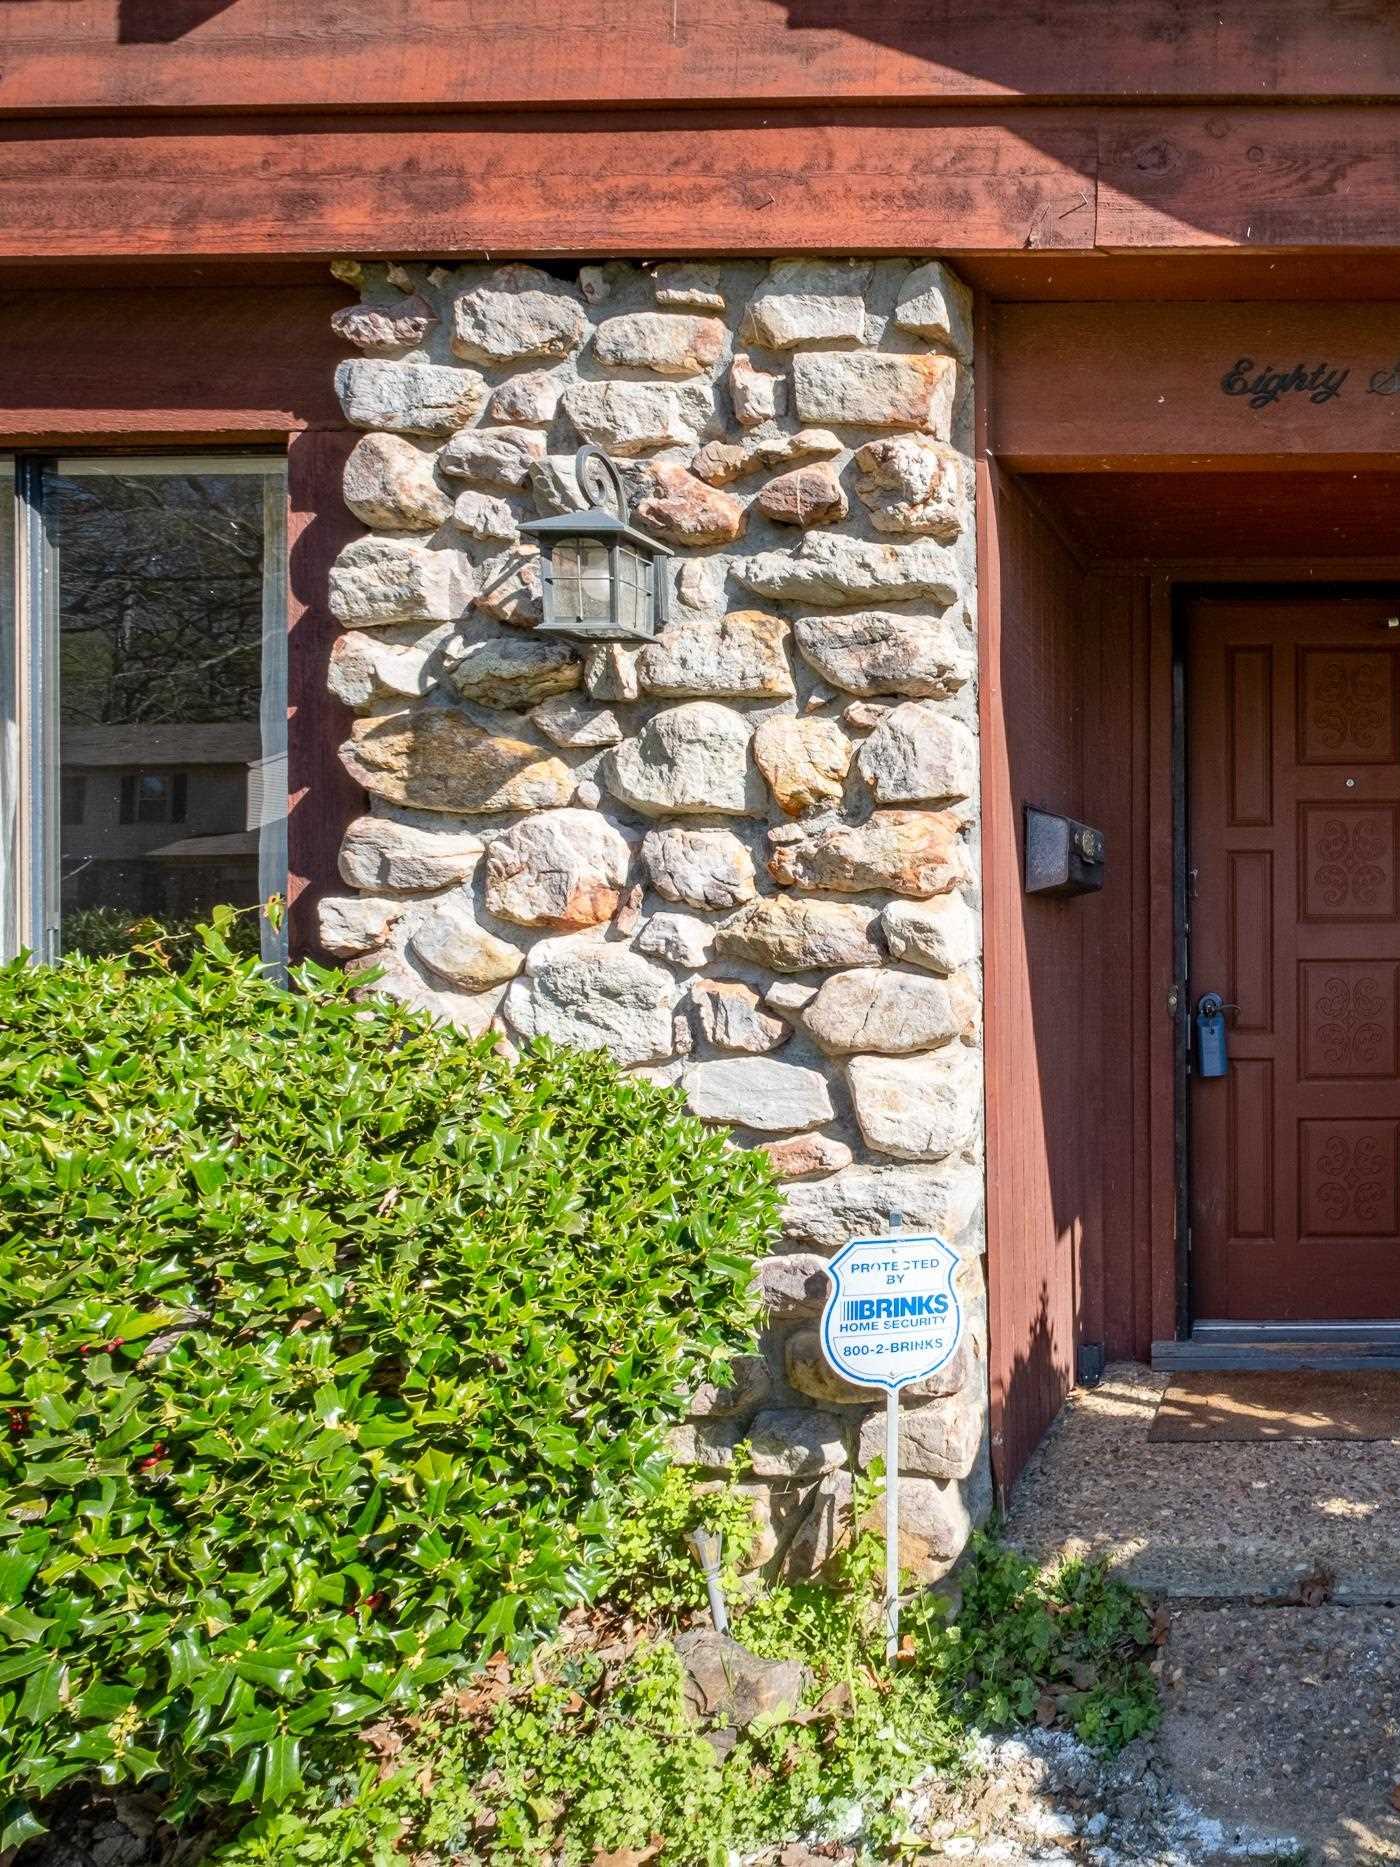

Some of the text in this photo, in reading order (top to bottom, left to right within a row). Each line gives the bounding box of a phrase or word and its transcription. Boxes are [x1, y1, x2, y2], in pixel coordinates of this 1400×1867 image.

[1221, 357, 1351, 409] Eighty
[886, 1274, 905, 1285] BY
[859, 1293, 949, 1320] BRINKS
[840, 1316, 947, 1333] HOME SECURITY
[843, 1338, 943, 1357] 800-2-BRINKS
